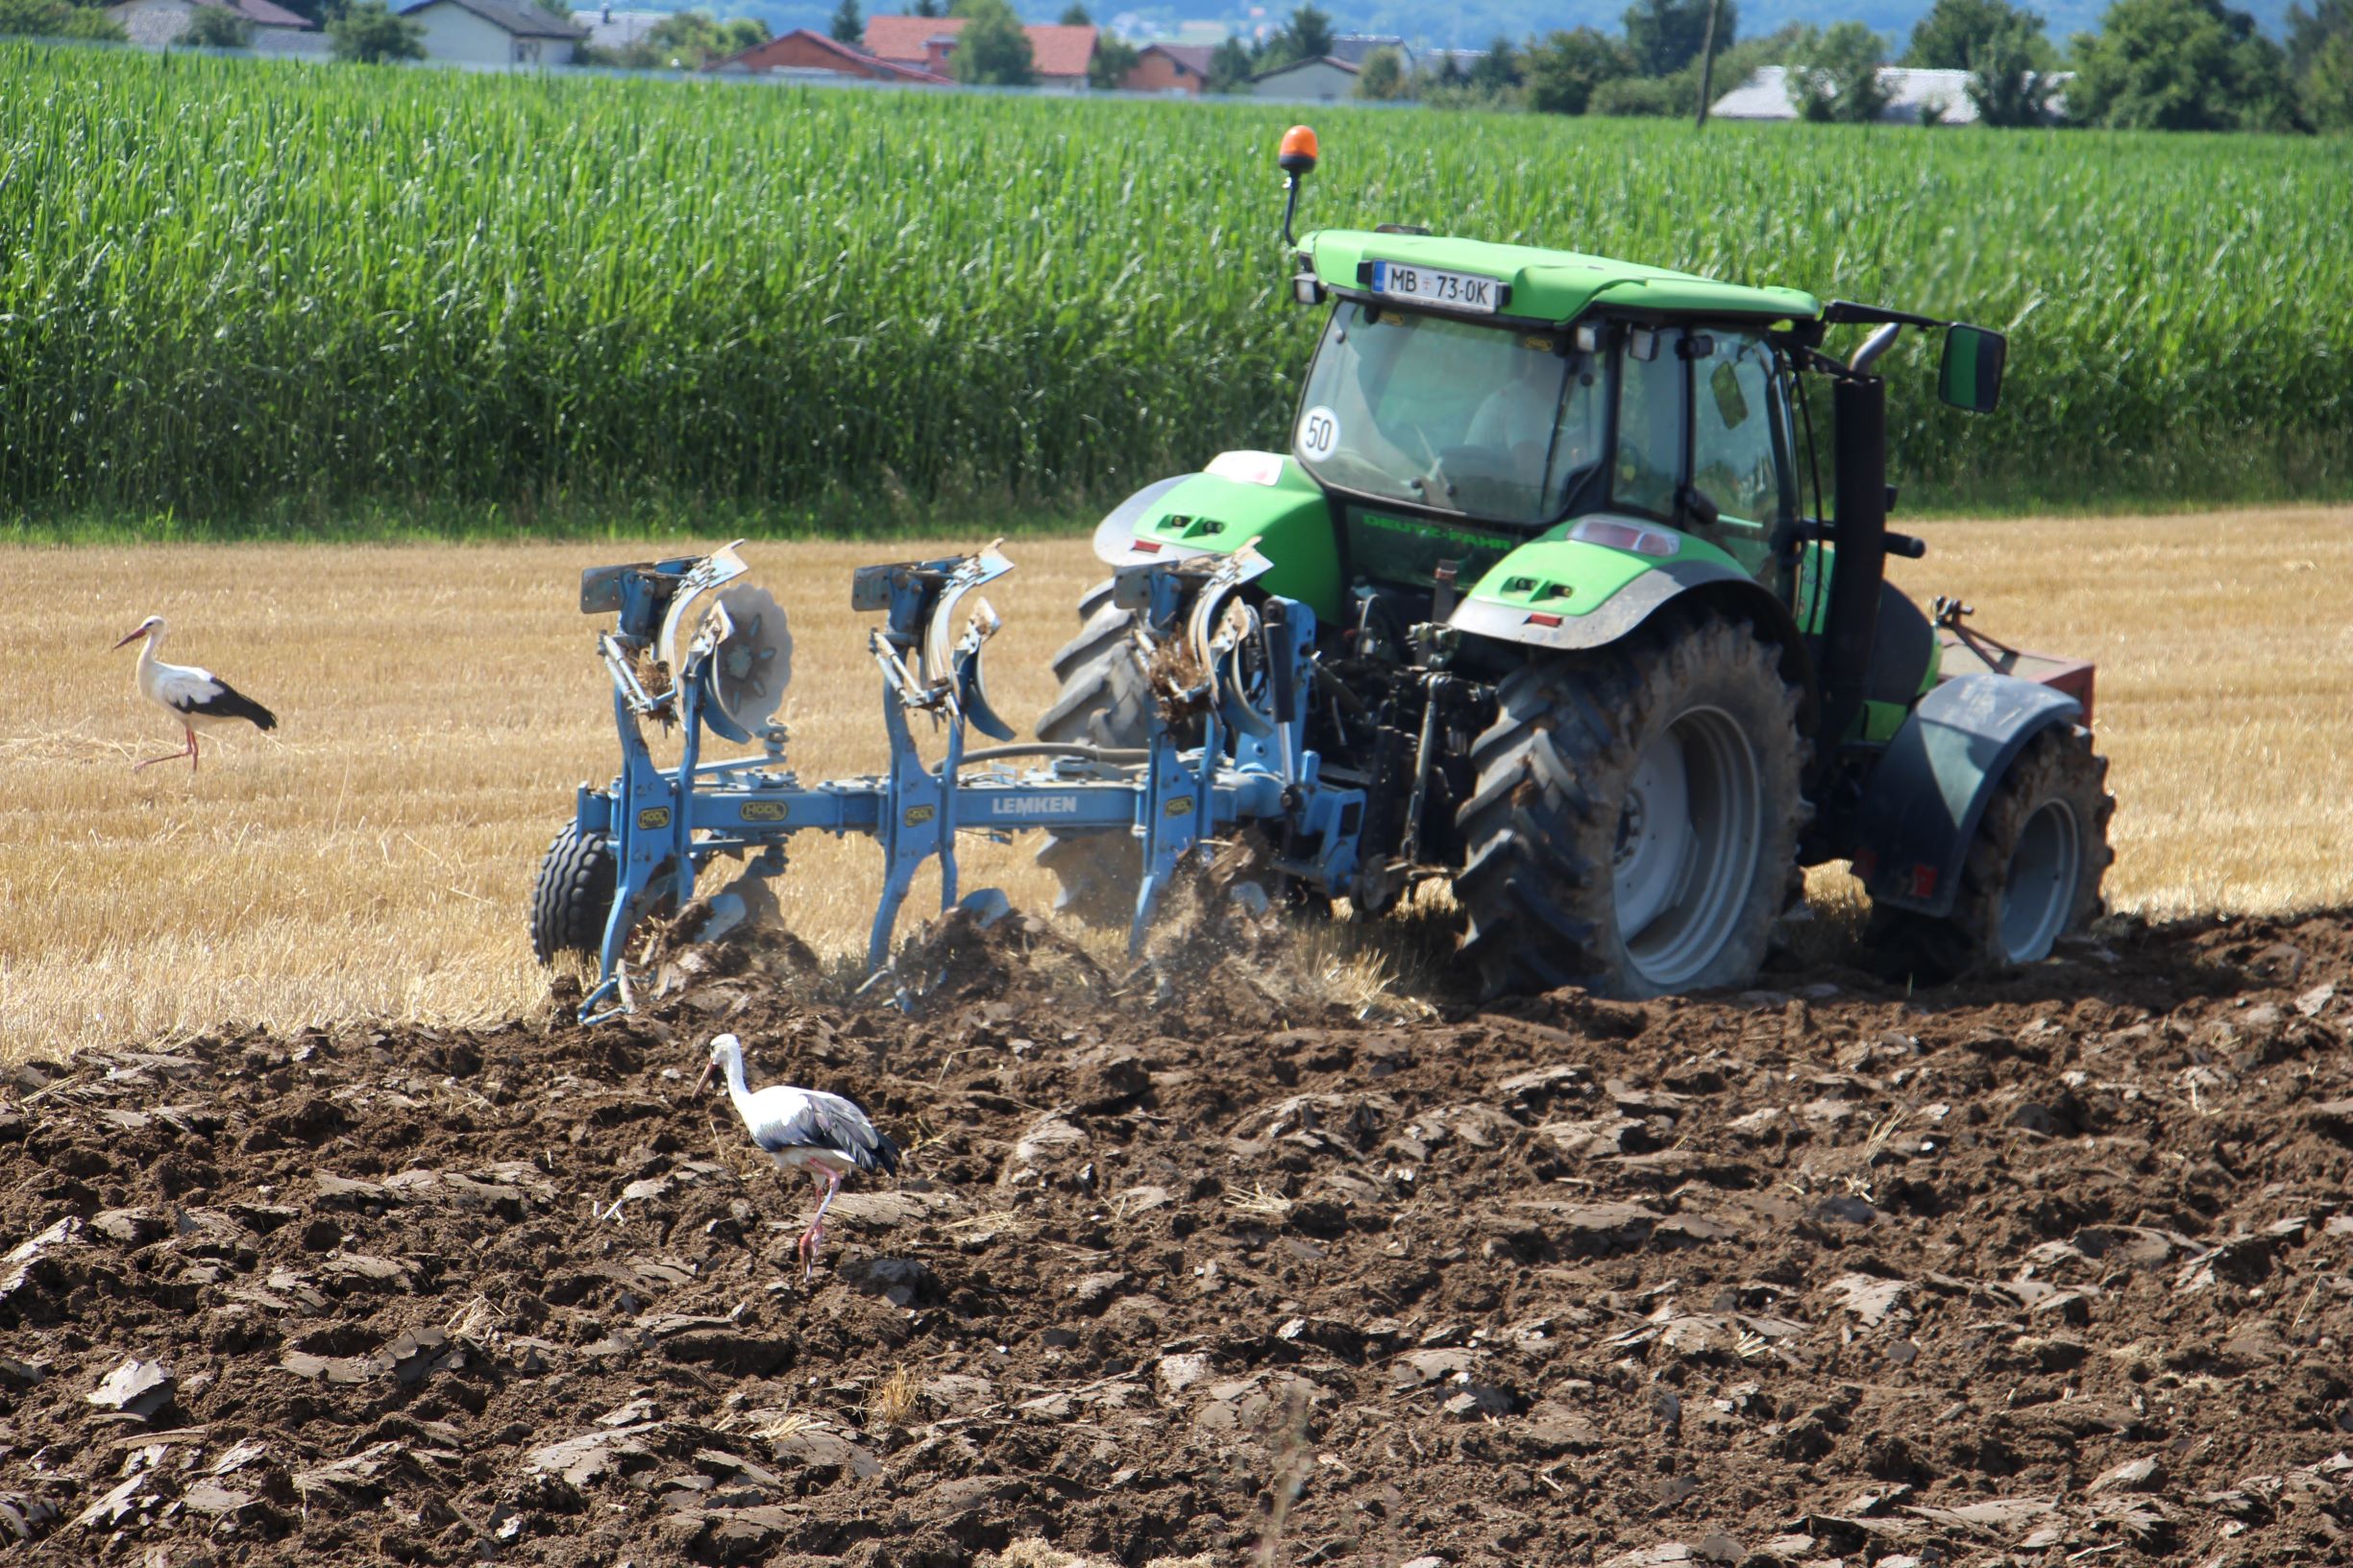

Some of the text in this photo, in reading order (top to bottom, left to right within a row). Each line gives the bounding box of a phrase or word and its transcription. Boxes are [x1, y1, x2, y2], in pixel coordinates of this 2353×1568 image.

[1390, 268, 1417, 292] MB
[1306, 415, 1333, 452] 50
[992, 796, 1077, 815] LEMKEN
